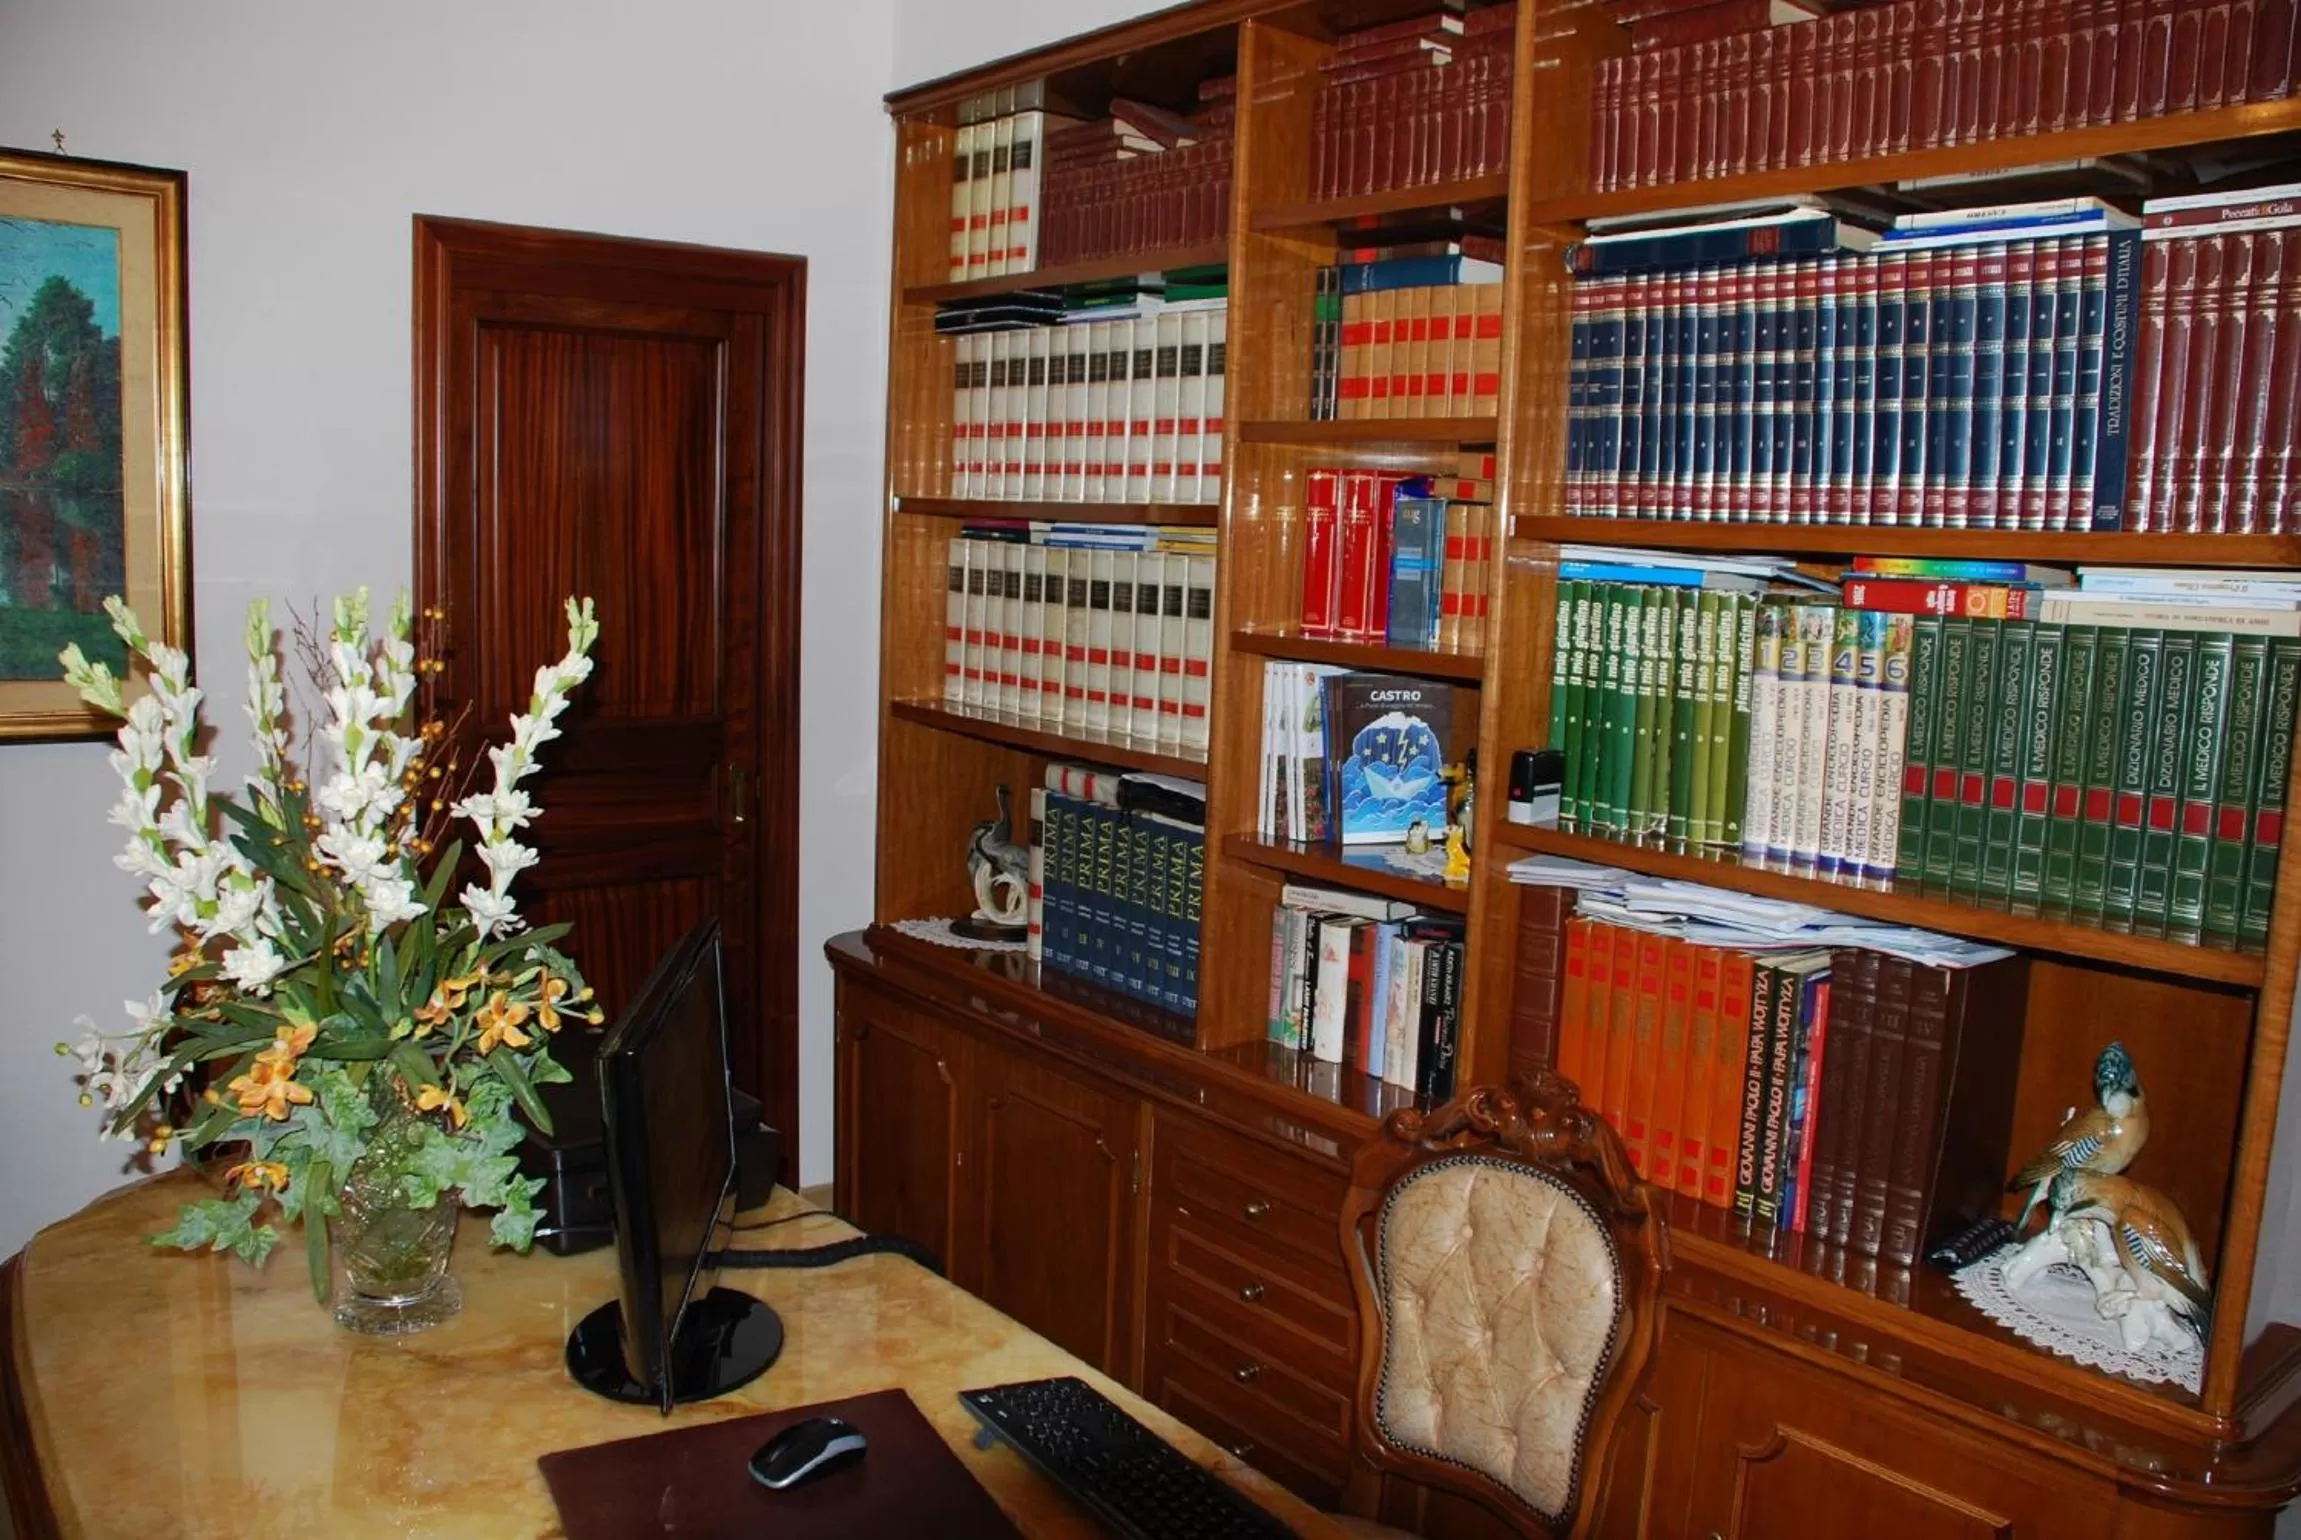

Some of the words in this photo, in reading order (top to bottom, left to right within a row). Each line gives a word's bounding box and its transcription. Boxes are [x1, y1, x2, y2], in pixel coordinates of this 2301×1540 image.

[2222, 206, 2259, 220] Peccati
[2267, 201, 2294, 215] Gola
[2112, 294, 2129, 350] COSTUMI
[2112, 352, 2125, 360] E
[2107, 364, 2124, 436] TRADIZIONI
[1557, 600, 1570, 649] giardino
[1573, 599, 1589, 649] giardino
[1608, 602, 1622, 651] giardino
[1624, 605, 1639, 656] giardino
[1641, 606, 1658, 658] giardino
[1680, 608, 1697, 660] giardino
[1697, 611, 1714, 663] giardino
[1716, 610, 1733, 663] giardino
[1738, 609, 1754, 673] medicinali
[1555, 651, 1567, 674] mio
[1570, 651, 1584, 674] mio
[1606, 654, 1618, 678] mio
[1622, 659, 1636, 683] mio
[1640, 660, 1653, 684] mio
[1678, 662, 1693, 687] mio
[1696, 665, 1709, 690] mio
[1715, 665, 1728, 690] mio
[1782, 647, 1798, 671] 2
[1835, 652, 1853, 674] 4
[1859, 655, 1876, 677] 5
[1886, 657, 1908, 680] 6
[2006, 645, 2022, 705] RISPONDE
[2037, 647, 2053, 708] RISPONDE
[2102, 652, 2118, 713] RISPONDE
[2134, 654, 2151, 707] MEDICO
[2166, 656, 2184, 709] MEDICO
[1370, 690, 1421, 702] CASTRO
[1734, 674, 1751, 713] piante
[2200, 660, 2220, 723] RISPONDE
[2236, 662, 2255, 728] RISPONDE
[2276, 664, 2295, 730] RISPONDE
[1774, 687, 1786, 783] ENCICLOPEDIA
[1827, 692, 1840, 788] ENCICLOPEDIA
[1850, 695, 1864, 793] ENCICLOPEDIA
[1875, 698, 1891, 797] ENCICLOPEDIA
[2001, 708, 2017, 758] MEDICO
[2033, 710, 2048, 761] MEDICO
[2097, 716, 2112, 768] MEDICO
[2127, 710, 2144, 785] DIZIONARIO
[2159, 712, 2178, 788] DIZIONARIO
[2195, 726, 2213, 780] MEDICO
[2230, 731, 2247, 786] MEDICO
[1784, 738, 1796, 786] CURCIO
[1836, 743, 1849, 792] CURCIO
[1859, 748, 1873, 798] CURCIO
[1888, 751, 1901, 802] CURCIO
[2268, 733, 2288, 788] MEDICO
[1770, 788, 1782, 843] GRANDE
[1780, 793, 1793, 844] MEDICA
[1822, 799, 1833, 850] GRANDE
[1832, 800, 1845, 852] MEDICA
[1845, 803, 1856, 856] GRANDE
[1855, 806, 1868, 858] MEDICA
[1872, 803, 1884, 860] GRANDE
[1881, 809, 1896, 862] MEDICA
[1079, 818, 1094, 889] PRIMA
[1097, 821, 1112, 893] PRIMA
[1115, 826, 1130, 899] PRIMA
[1132, 832, 1148, 905] PRIMA
[1151, 836, 1166, 911] PRIMA
[1168, 842, 1185, 916] PRIMA
[1187, 846, 1203, 922] PRIMA
[1750, 1034, 1765, 1065] PAPA
[1773, 1040, 1788, 1073] PAPA
[1745, 1080, 1761, 1121] PAOLO
[1767, 1086, 1783, 1130] PAOLO
[1740, 1121, 1757, 1185] GIOVANNI
[1761, 1129, 1779, 1194] GIOVANNI
